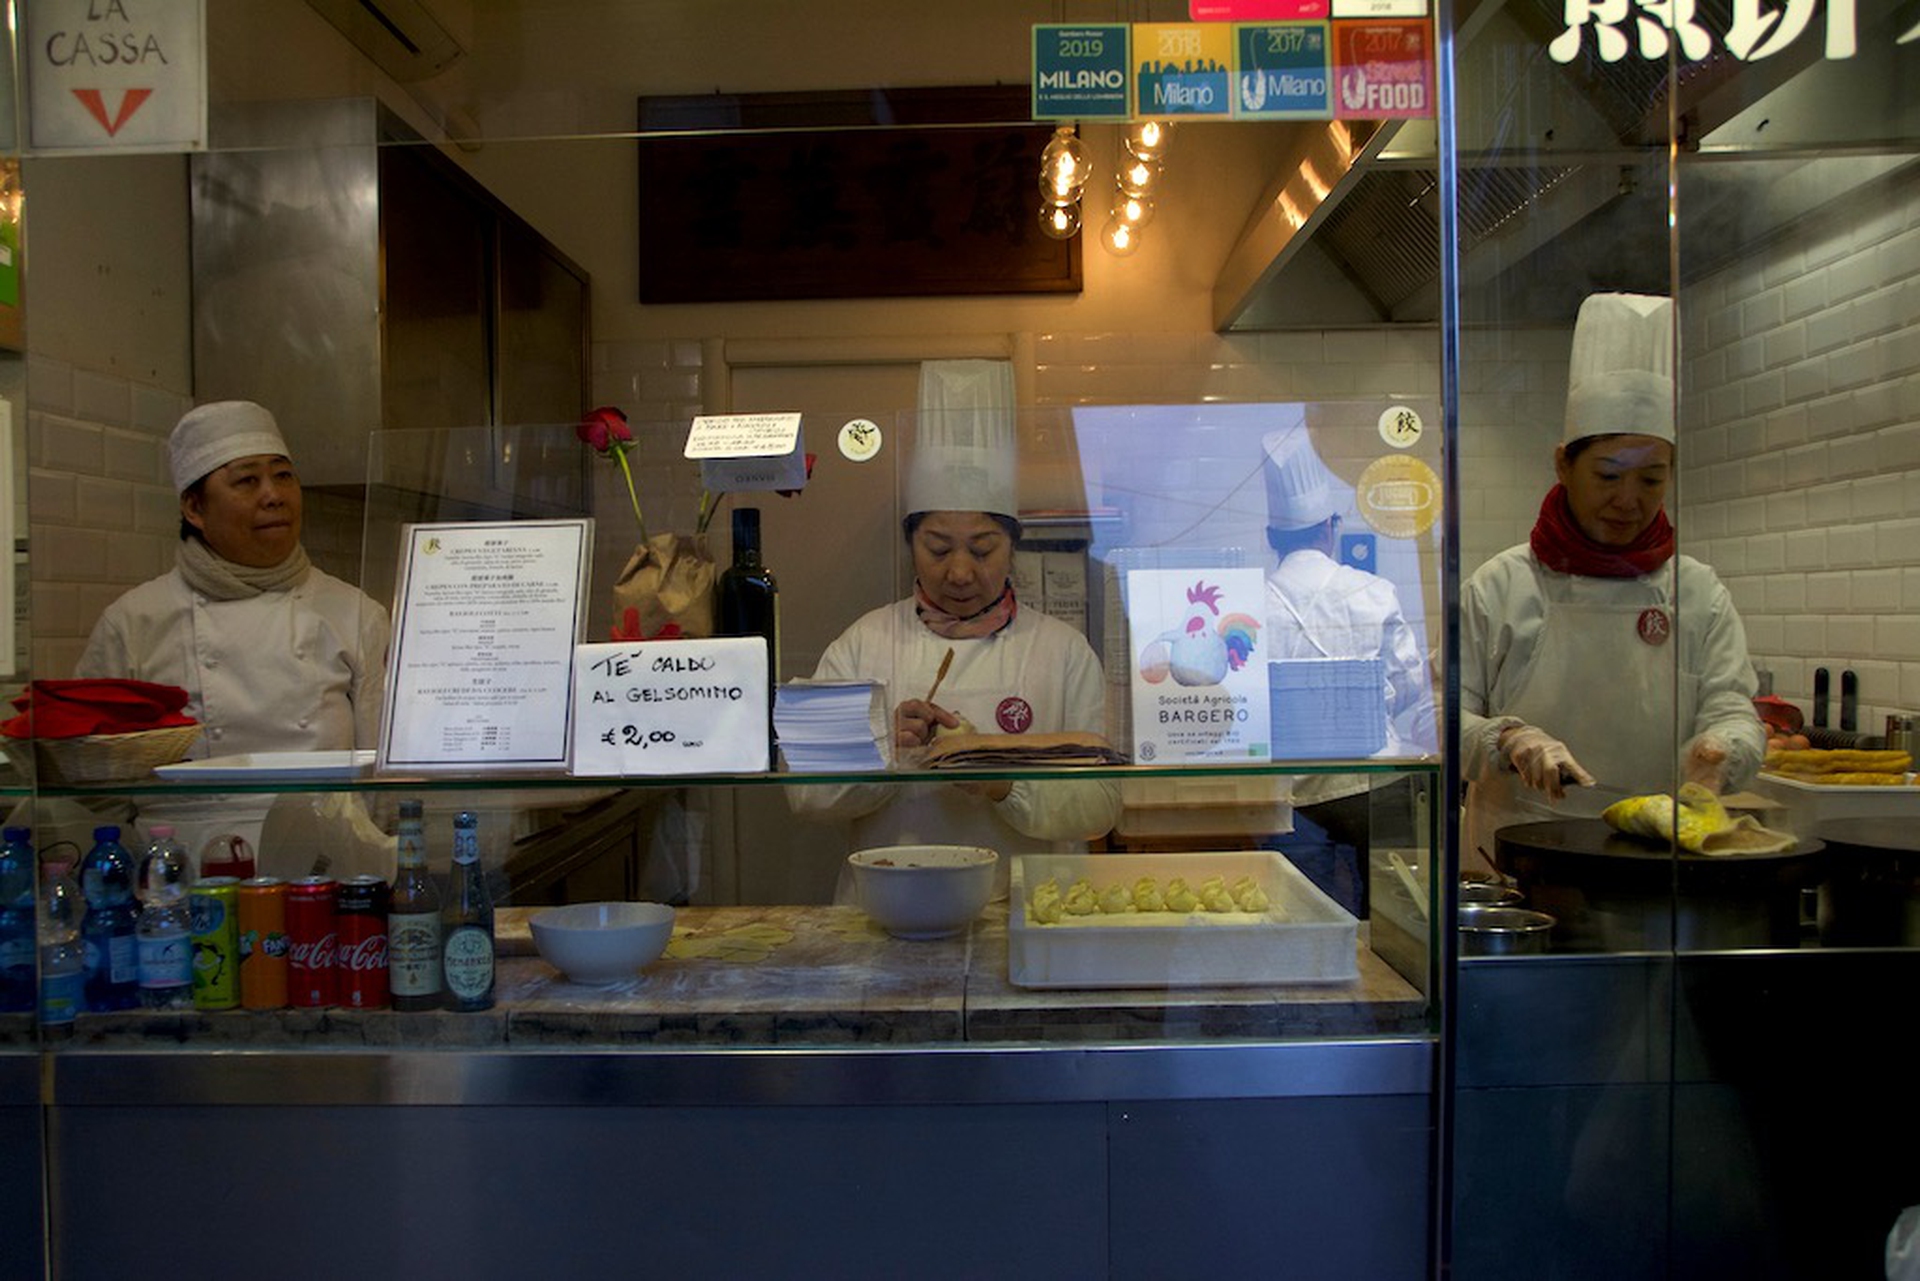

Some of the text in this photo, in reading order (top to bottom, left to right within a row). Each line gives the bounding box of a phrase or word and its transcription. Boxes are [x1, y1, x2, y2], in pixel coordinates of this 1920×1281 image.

[87, 0, 129, 23] LA
[46, 31, 168, 66] CASSA
[1059, 40, 1104, 57] 2019
[1158, 33, 1202, 57] 2018
[1267, 32, 1305, 53] 2017
[1039, 69, 1124, 89] MILANO
[1268, 75, 1326, 97] Milano
[1154, 82, 1214, 105] Milano
[1367, 83, 1425, 110] FOOD
[652, 656, 716, 673] CALDO
[592, 686, 743, 704] AL GELSOMINO
[1203, 694, 1248, 707] Agricola
[1158, 708, 1249, 723] BARGERO
[622, 724, 676, 749] 2,00
